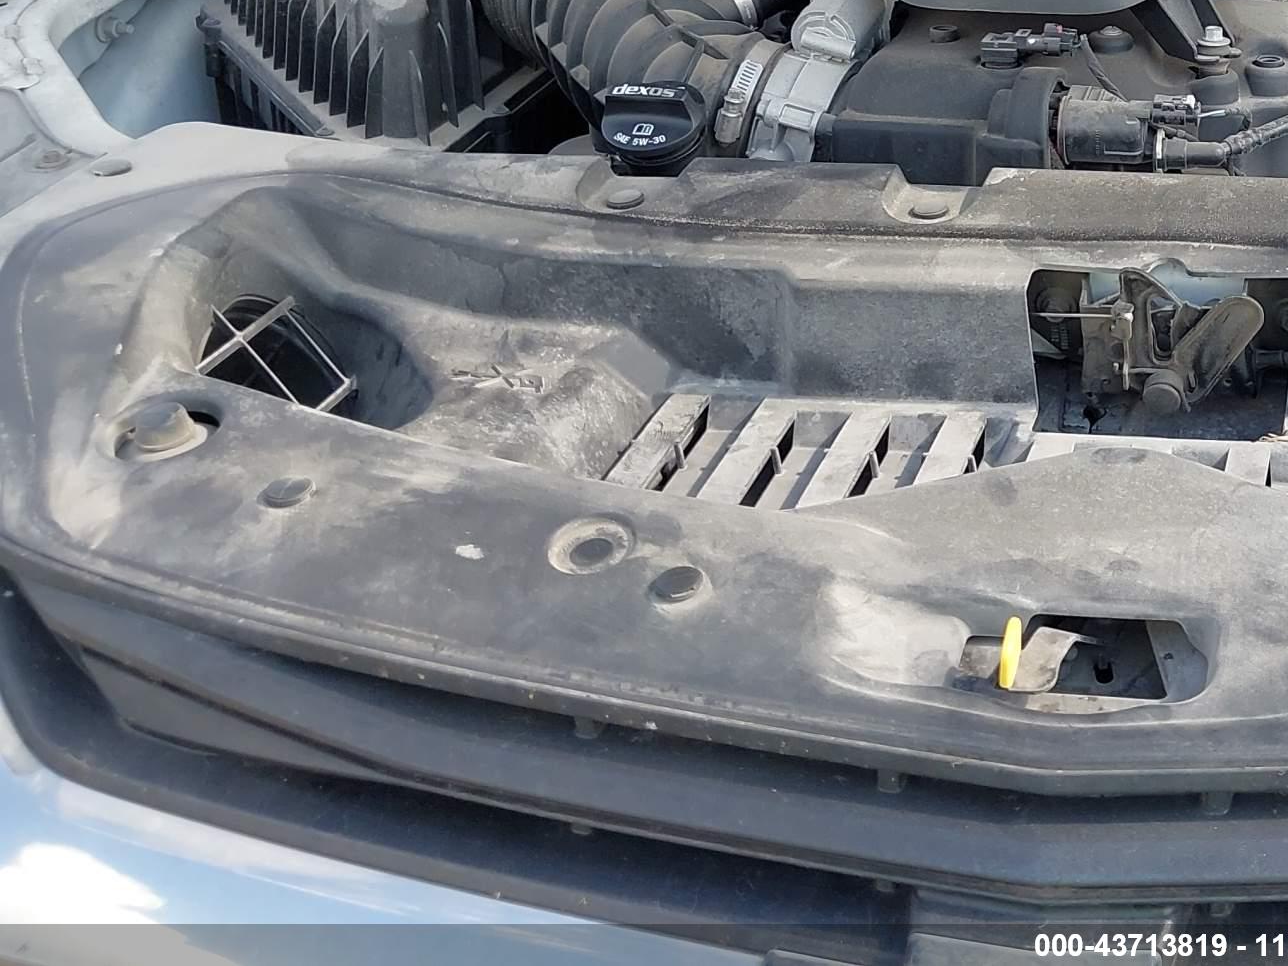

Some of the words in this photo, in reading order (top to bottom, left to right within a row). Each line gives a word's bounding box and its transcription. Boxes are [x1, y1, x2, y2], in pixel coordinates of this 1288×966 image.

[612, 83, 678, 98] dexos
[613, 132, 631, 145] SAE
[632, 134, 667, 146] 5W-30
